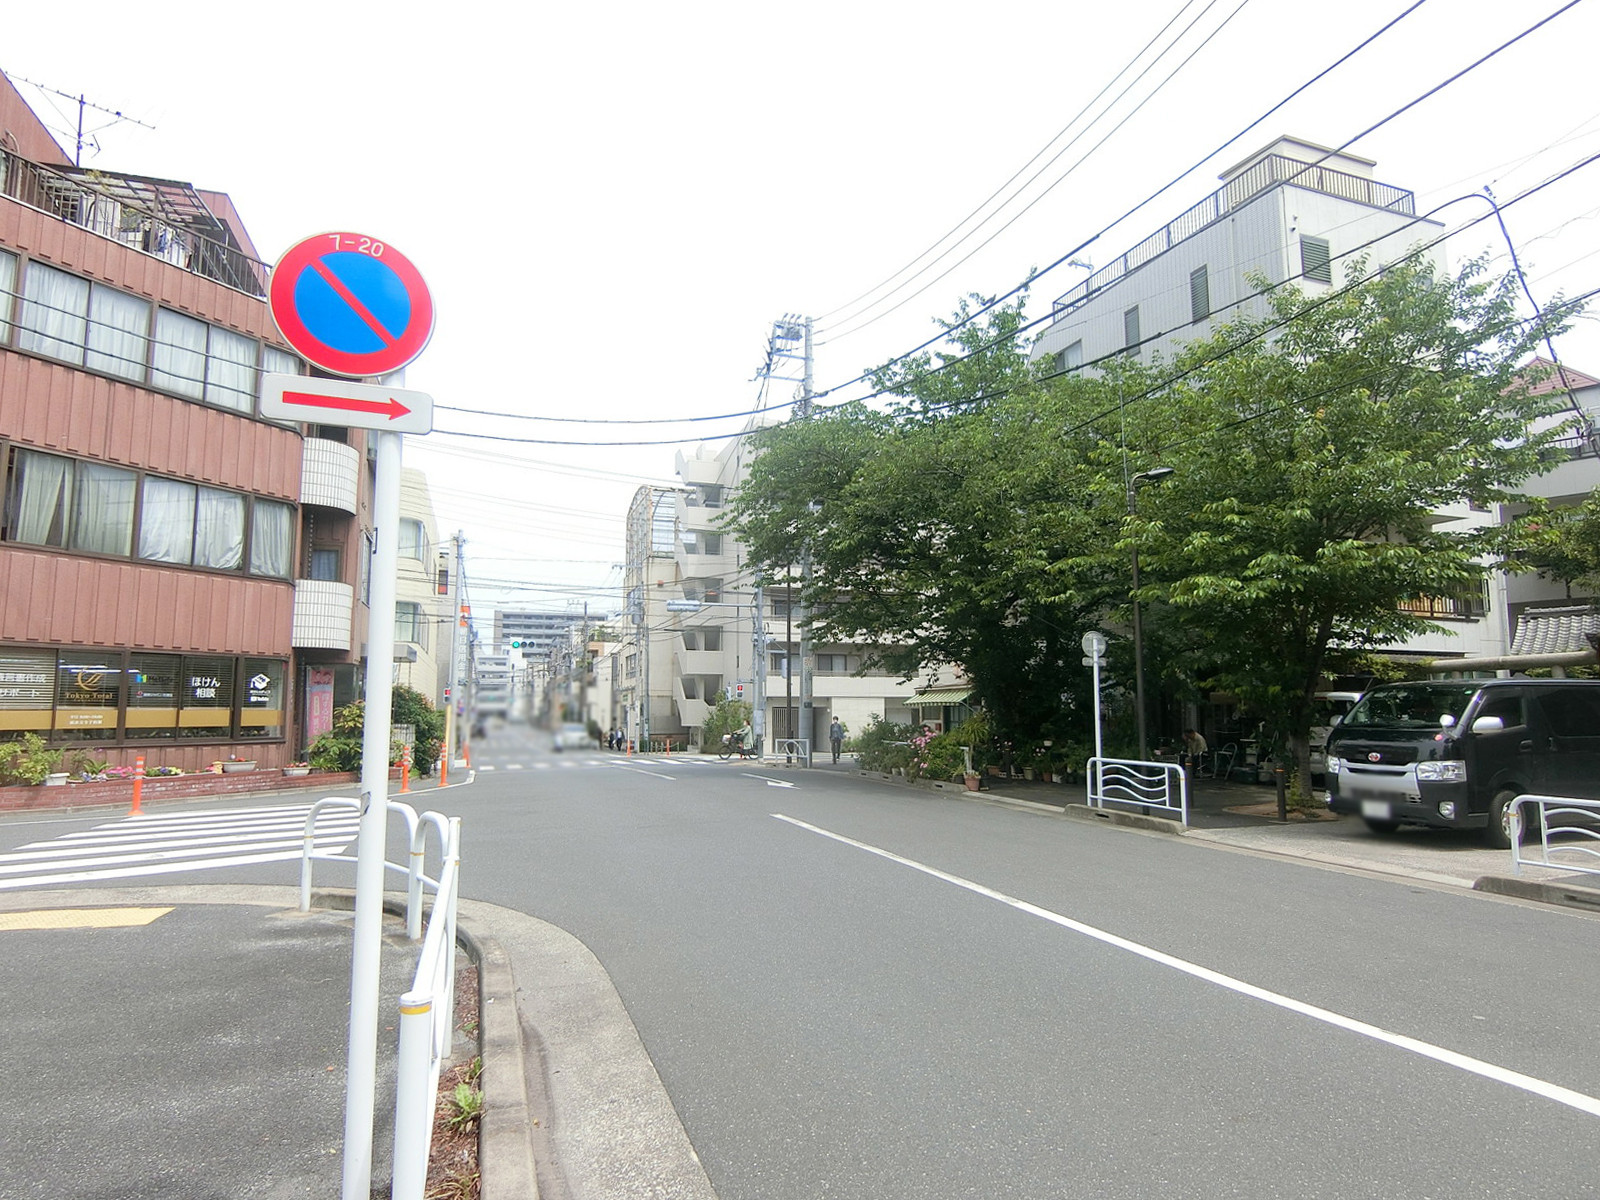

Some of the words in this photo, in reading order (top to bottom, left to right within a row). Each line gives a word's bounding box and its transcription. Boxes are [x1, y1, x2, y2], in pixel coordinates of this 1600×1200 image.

[328, 234, 384, 257] 7-20
[191, 676, 221, 688] ほけん
[65, 692, 90, 700] Tokyo
[93, 692, 113, 700] Total
[195, 688, 216, 698] 相談
